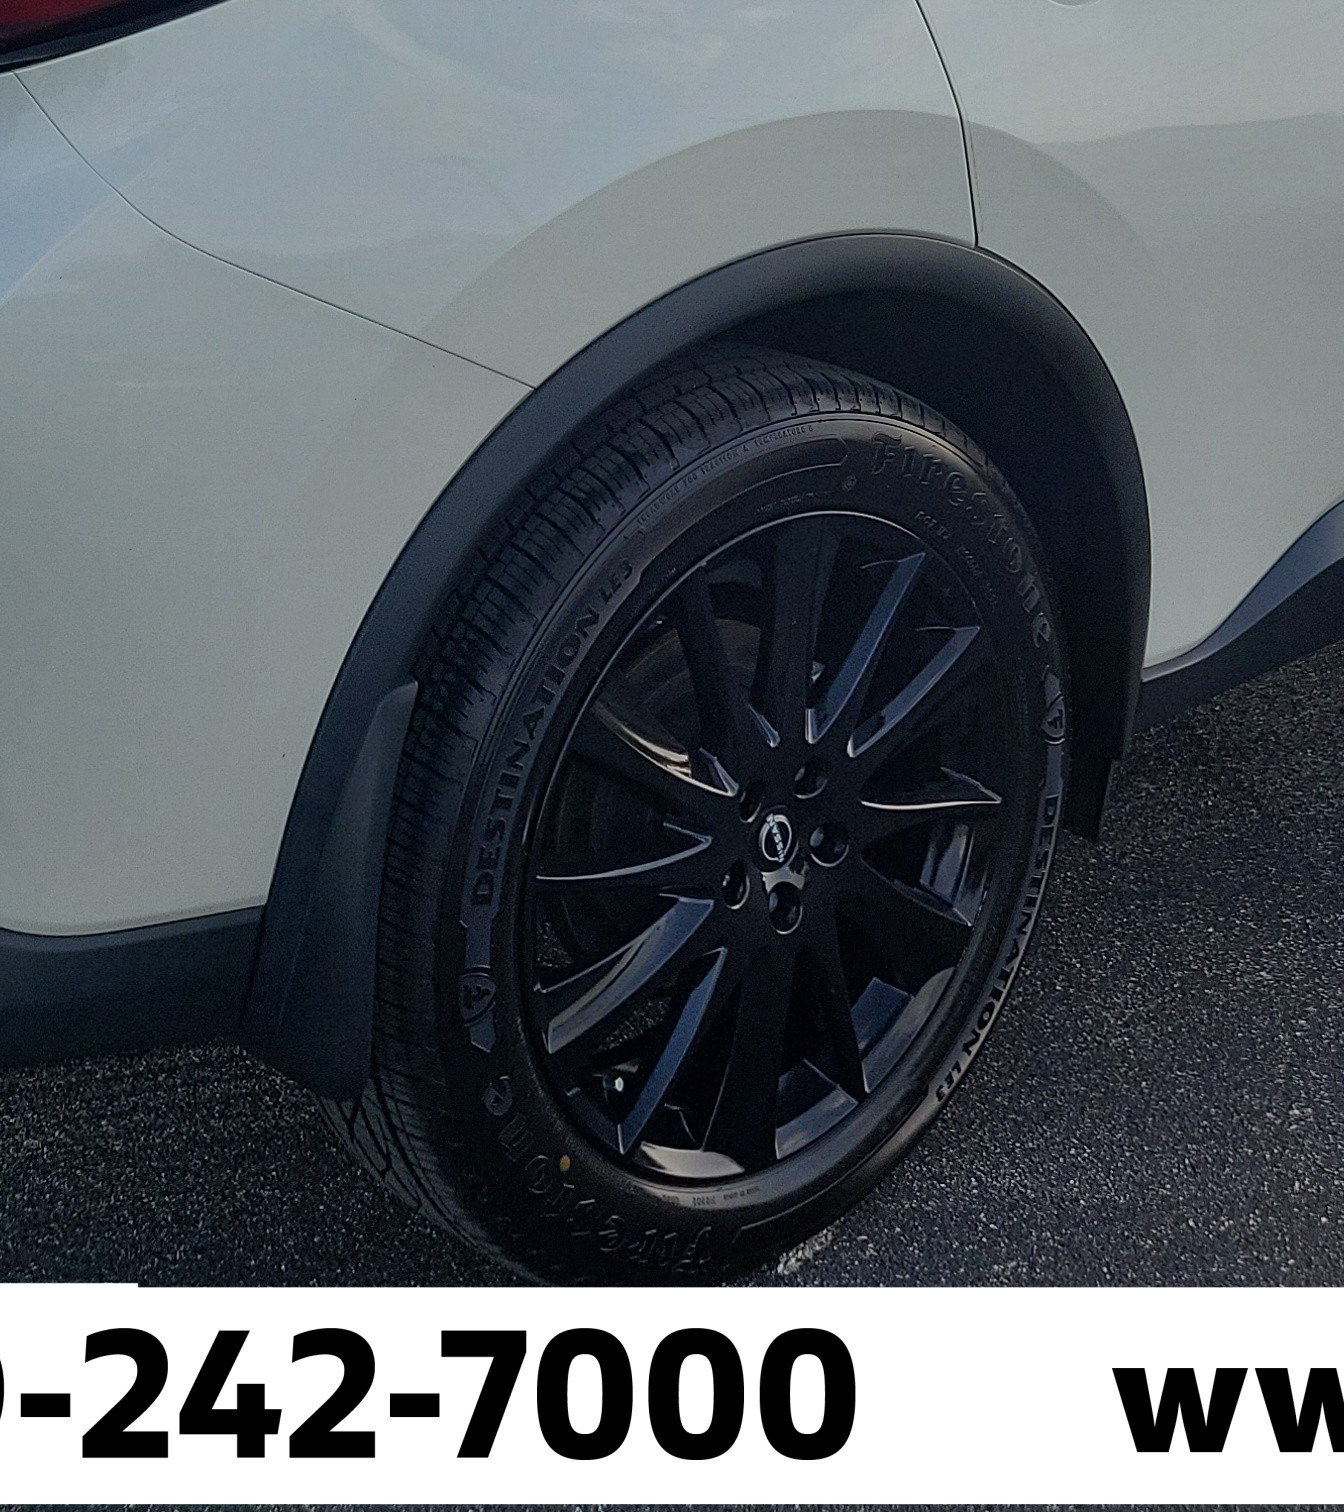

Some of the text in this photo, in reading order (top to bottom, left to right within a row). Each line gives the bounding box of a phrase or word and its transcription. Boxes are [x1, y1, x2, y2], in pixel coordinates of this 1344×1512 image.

[469, 602, 600, 907] DESTINATION
[935, 794, 1060, 1103] DESTINATION LE3
